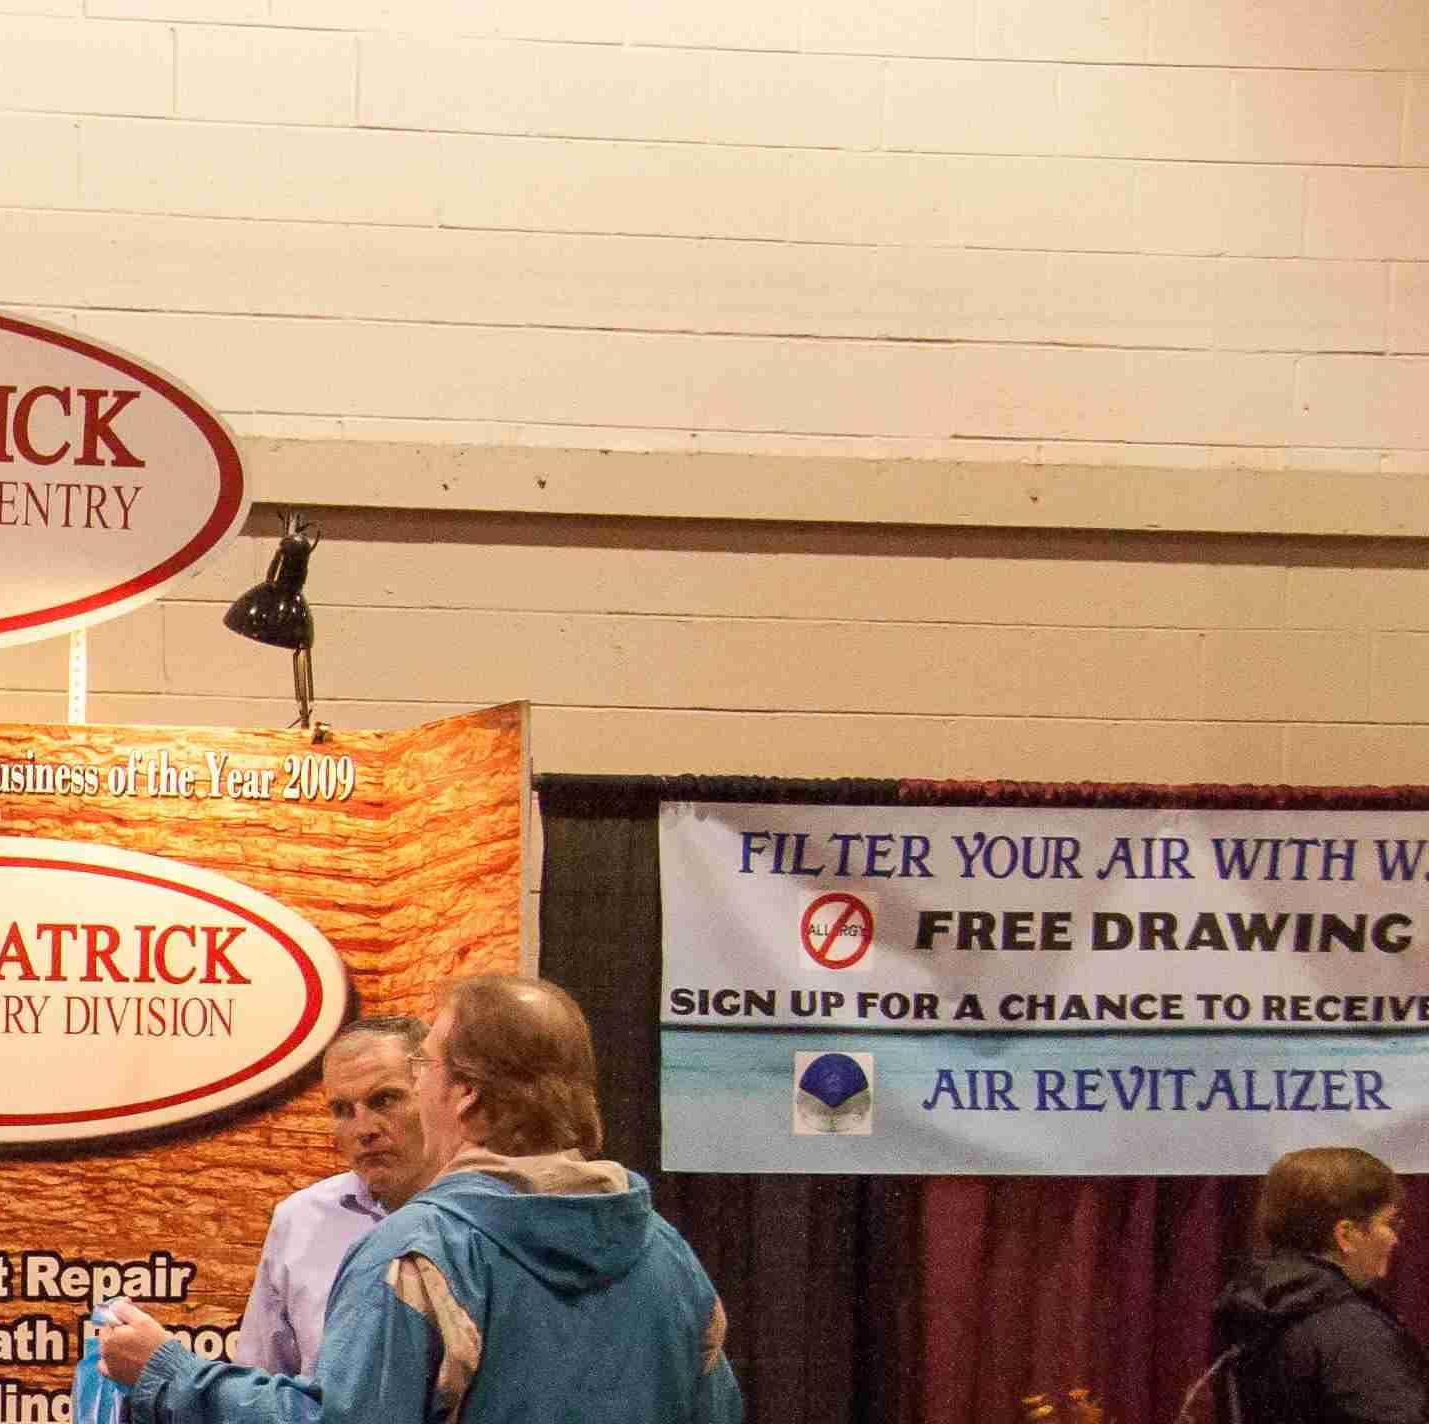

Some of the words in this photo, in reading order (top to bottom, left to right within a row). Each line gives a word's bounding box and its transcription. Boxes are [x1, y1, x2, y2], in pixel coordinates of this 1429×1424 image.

[108, 750, 143, 797] of
[148, 750, 196, 798] the
[204, 752, 276, 799] Year
[282, 753, 356, 801] 2009
[739, 831, 932, 878] FILTER
[952, 832, 1082, 880] YOUR
[1097, 836, 1196, 881] AIR
[1211, 837, 1359, 881] WITH
[915, 911, 1074, 951] FREE
[1091, 911, 1413, 953] DRAWING
[62, 995, 234, 1039] DIVISION
[669, 988, 776, 1018] SIGN
[790, 989, 845, 1018] UP
[857, 991, 940, 1020] FOR
[954, 992, 986, 1020] A
[998, 992, 1184, 1021] CHANCE
[1196, 993, 1251, 1021] TO
[922, 1067, 1021, 1112] AIR
[1034, 1065, 1393, 1112] REVITALIZER
[26, 1256, 192, 1307] Repair
